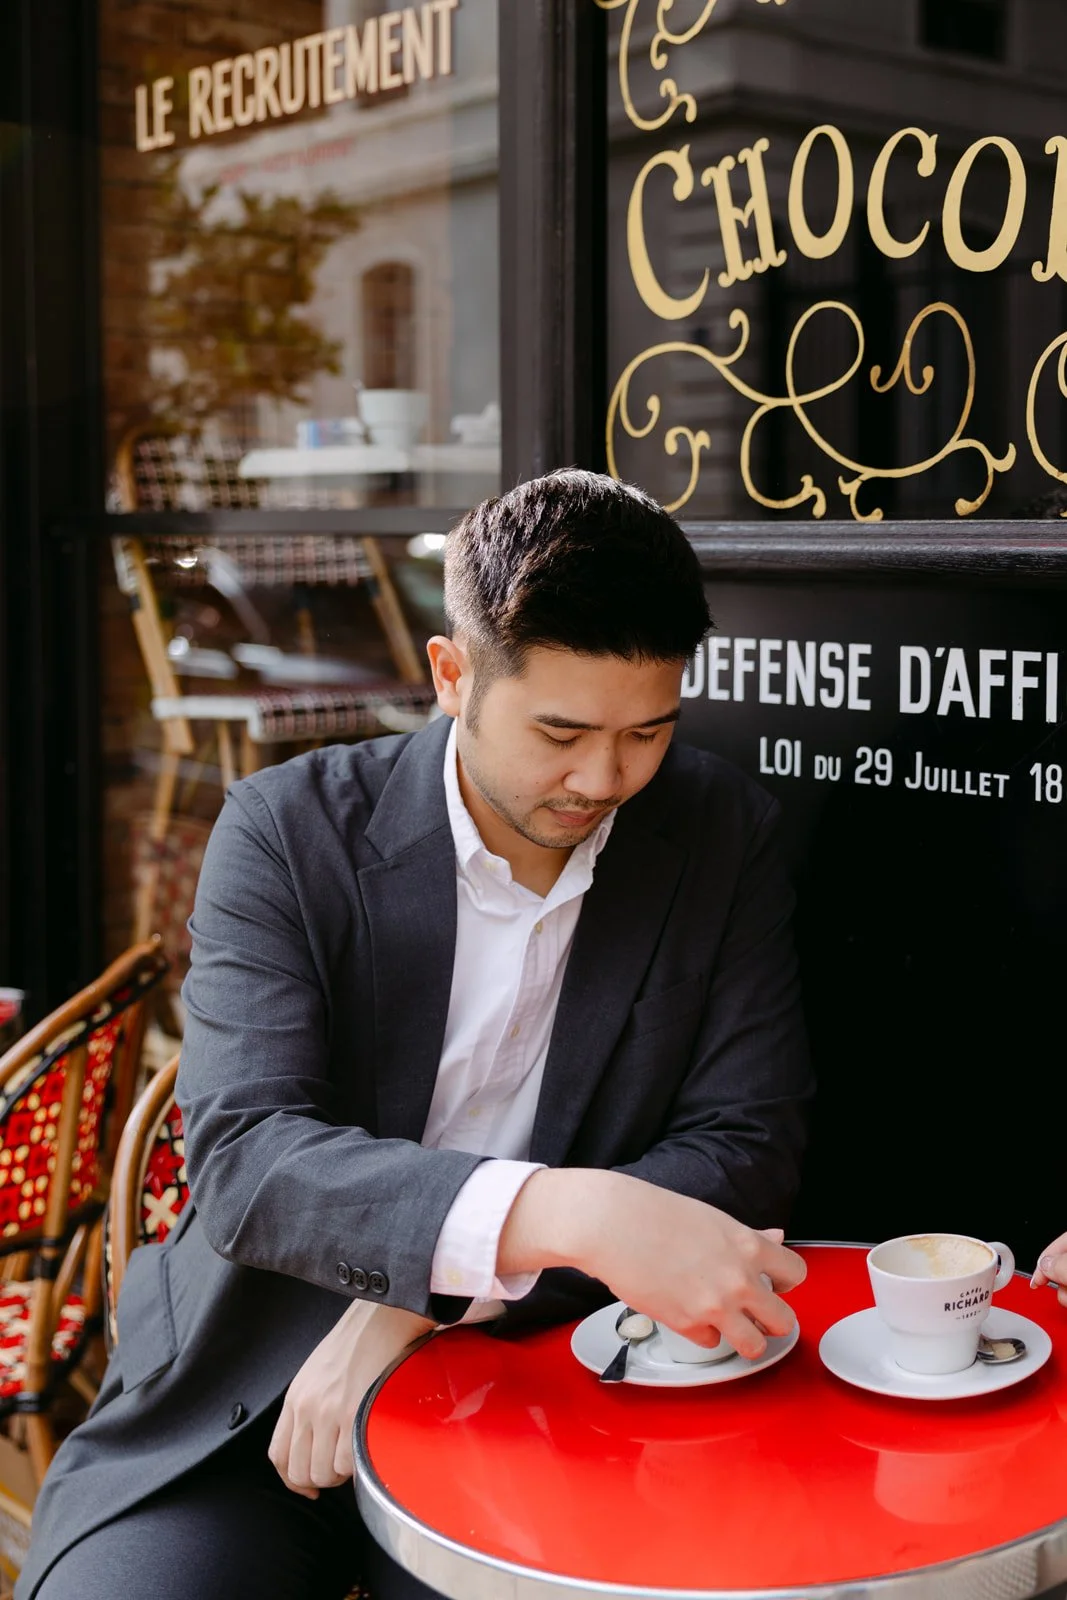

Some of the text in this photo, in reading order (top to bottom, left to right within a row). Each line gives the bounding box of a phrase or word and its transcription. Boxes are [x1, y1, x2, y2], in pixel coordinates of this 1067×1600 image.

[135, 0, 458, 152] LE RECRUTEMENT
[759, 736, 801, 778] LOI
[814, 755, 842, 782] DU
[854, 746, 893, 787] 29
[1029, 763, 1063, 804] 18
[944, 1290, 990, 1312] RICHARD
